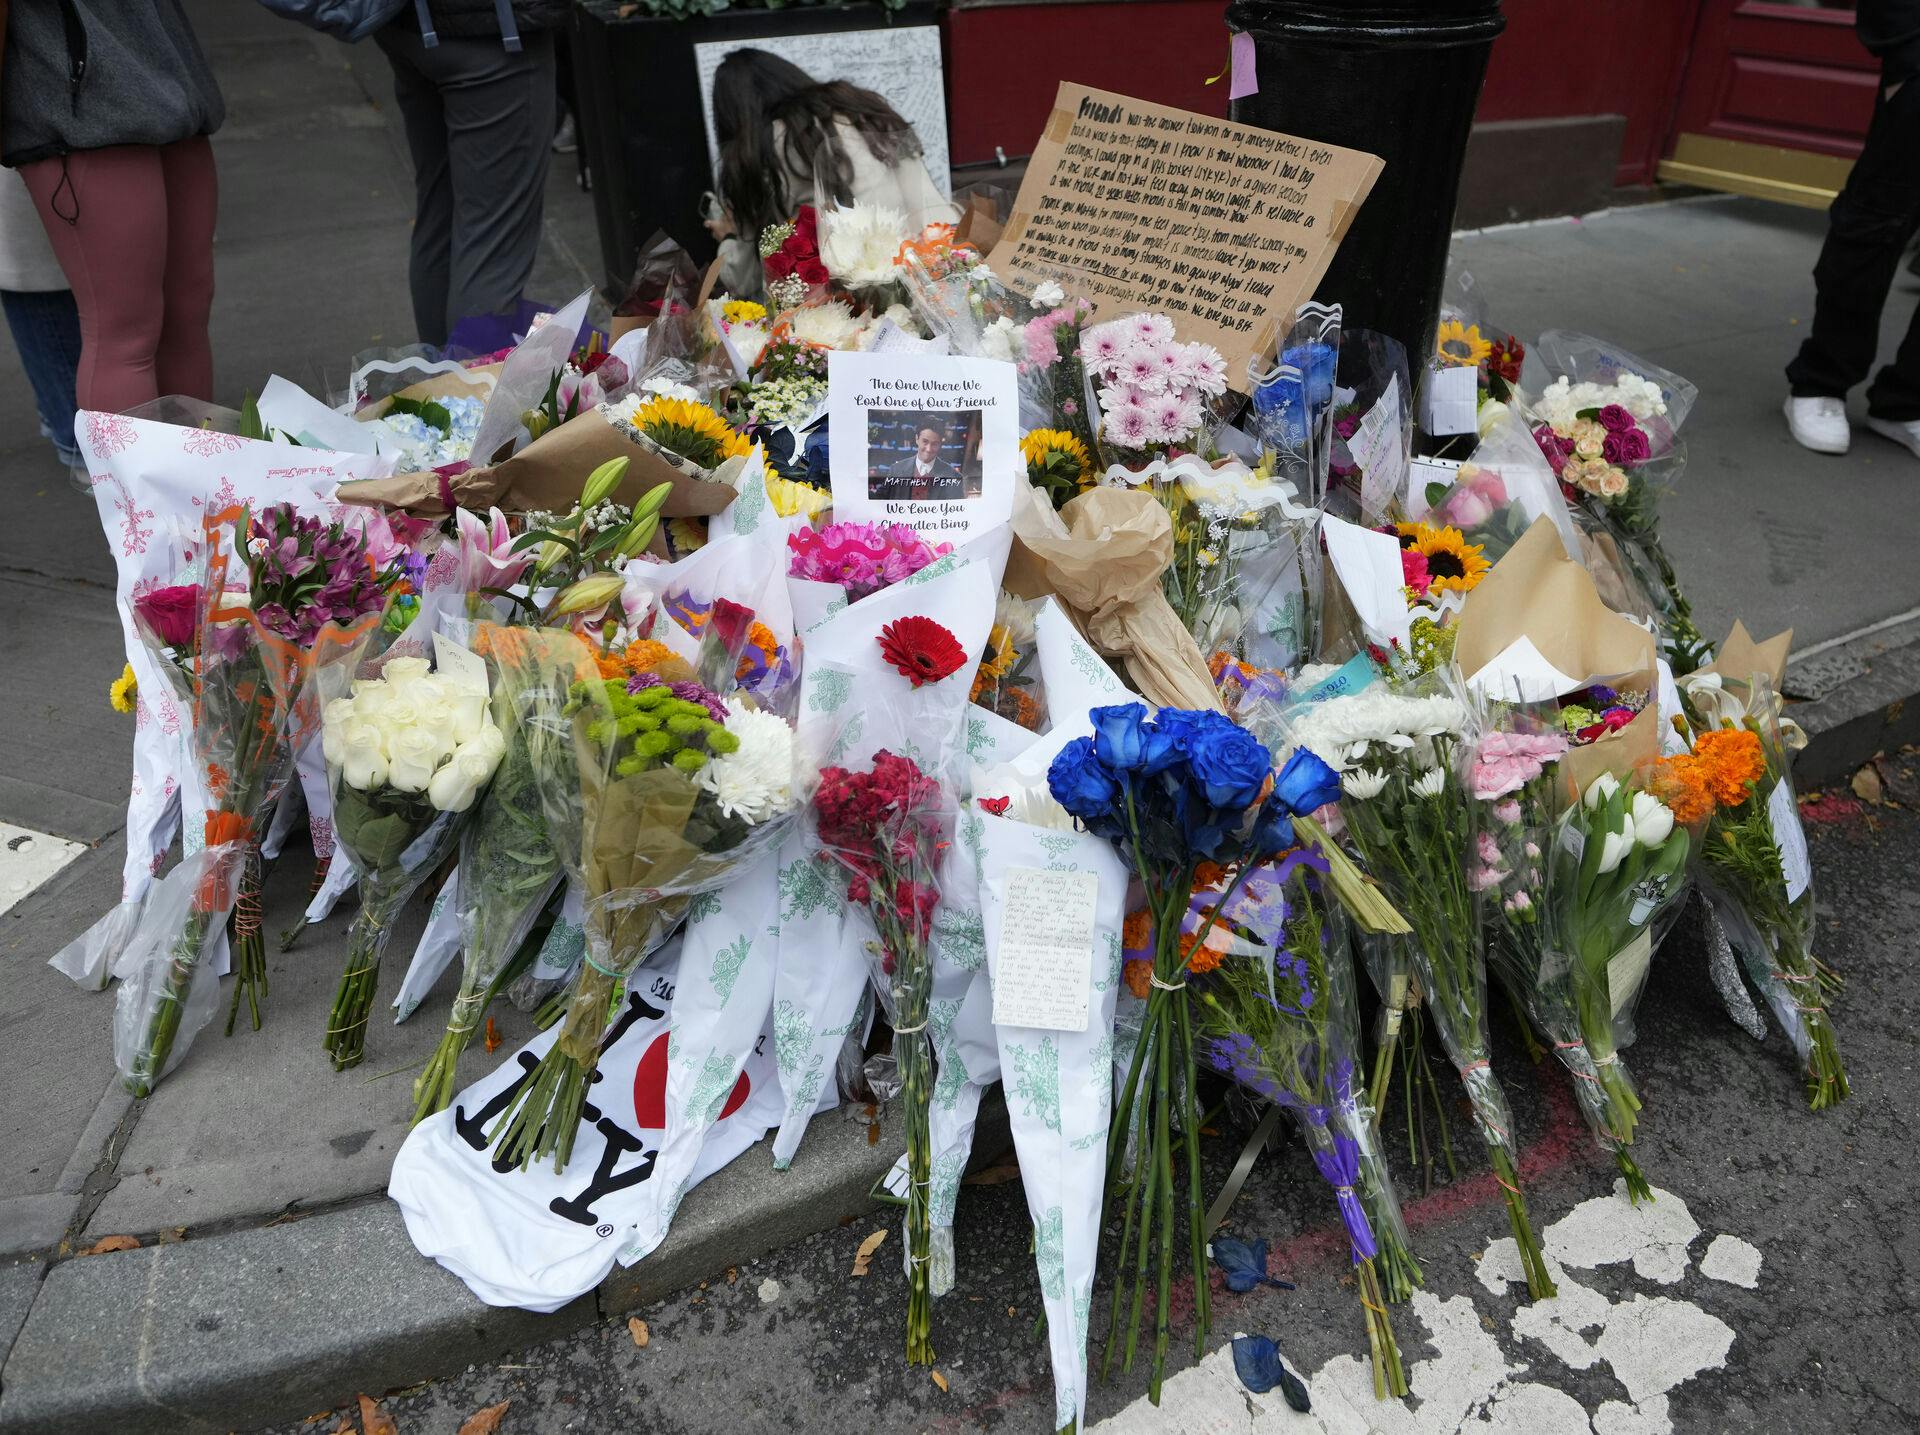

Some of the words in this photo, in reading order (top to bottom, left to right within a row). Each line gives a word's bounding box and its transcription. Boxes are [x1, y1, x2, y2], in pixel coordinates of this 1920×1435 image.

[869, 378, 892, 390] The
[894, 379, 919, 391] One
[921, 380, 961, 391] Where
[962, 380, 982, 390] We
[854, 395, 882, 406] Lost
[884, 396, 910, 407] One
[911, 397, 925, 410] of
[926, 397, 952, 408] Our
[952, 396, 997, 408] Friend
[884, 477, 927, 487] MATTHEW
[933, 476, 961, 487] PERRY
[886, 503, 906, 514] We
[907, 503, 938, 514] Love
[940, 503, 965, 516] You
[940, 519, 970, 531] Bing
